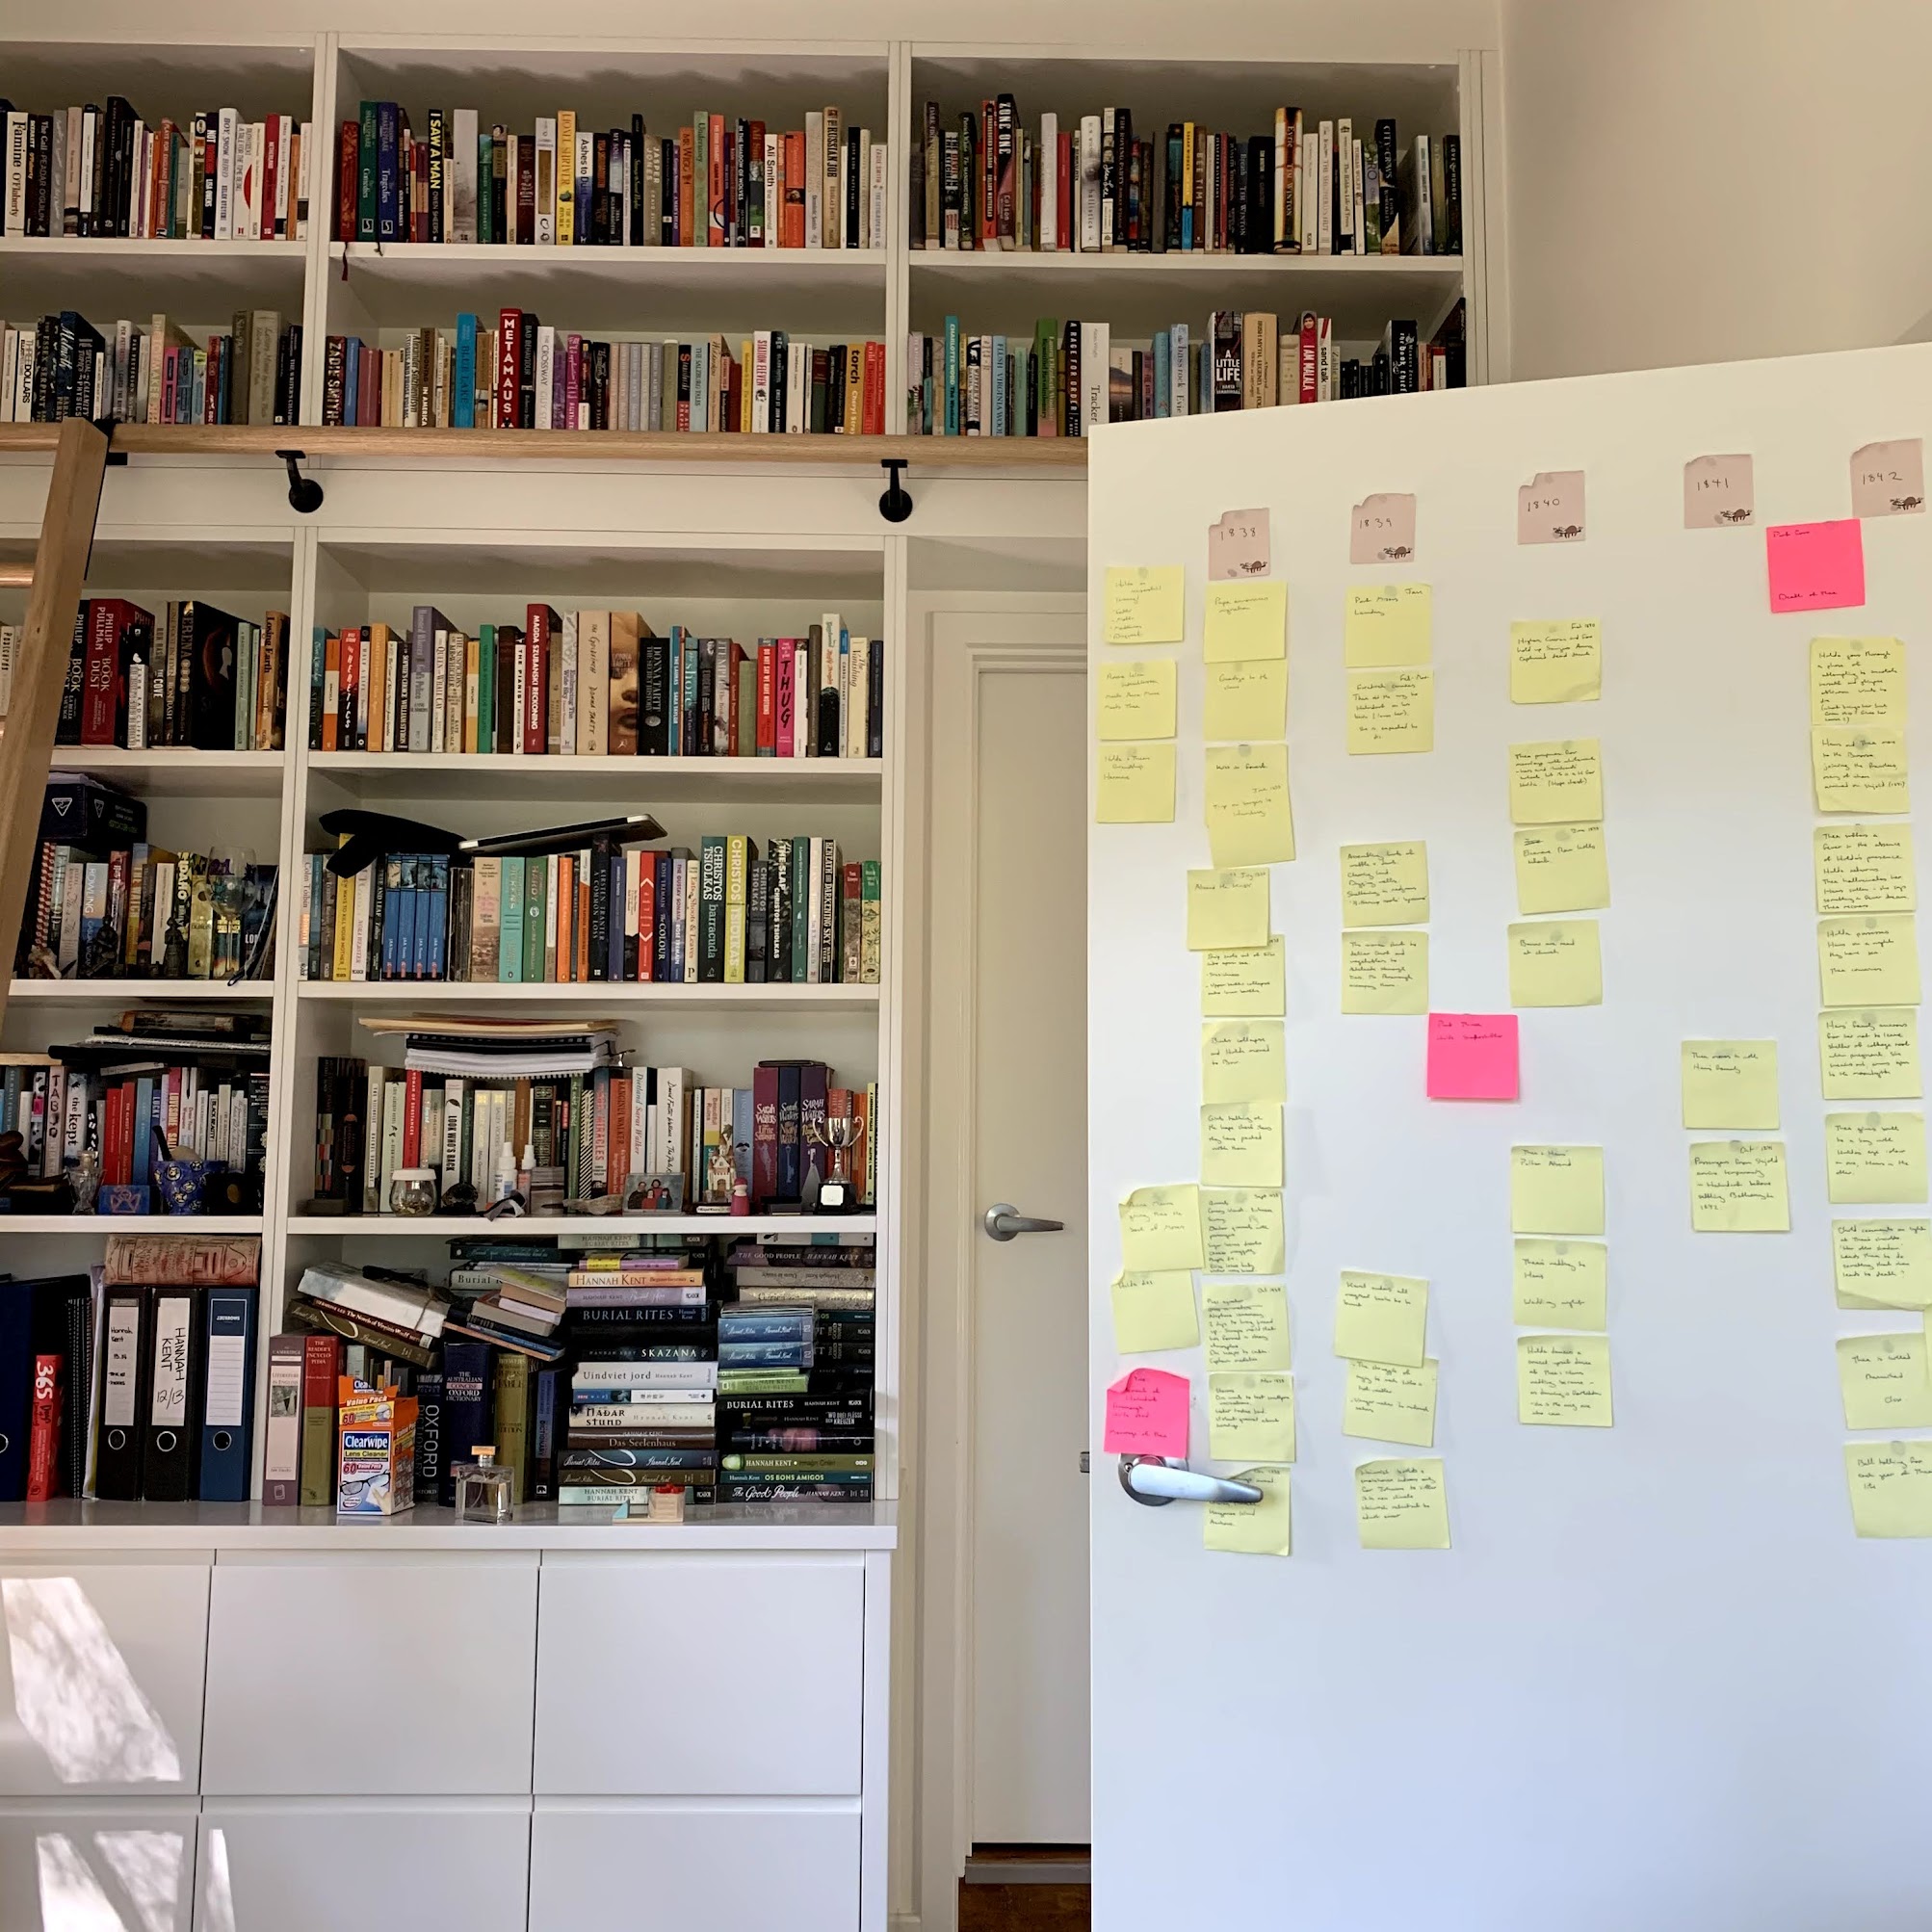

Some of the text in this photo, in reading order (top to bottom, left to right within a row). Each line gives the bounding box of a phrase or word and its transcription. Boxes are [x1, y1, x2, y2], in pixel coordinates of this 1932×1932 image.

[999, 103, 1011, 129] ZONE
[430, 120, 440, 147] SAW
[999, 134, 1011, 154] ONE
[430, 149, 440, 157] A
[580, 139, 589, 165] Ashes
[10, 121, 26, 217] Famine O'Flaherty
[430, 161, 440, 189] MAN
[767, 160, 775, 187] Smith
[380, 169, 390, 203] Tragedies
[59, 323, 75, 370] Melmoth
[1303, 349, 1315, 360] AM
[503, 318, 515, 413] METAMAUS
[756, 340, 767, 386] STATION ELEVEN
[1216, 368, 1241, 381] LIFE
[1303, 362, 1314, 390] MALALA
[39, 366, 47, 407] SERPENT
[327, 342, 341, 419] ZADIE SMITH
[850, 350, 860, 414] torch Cheryl
[1176, 346, 1187, 413] bass rock Evie
[1090, 385, 1100, 422] Tracker
[1862, 472, 1903, 485] 1842
[1528, 498, 1560, 512] 1840
[1221, 527, 1256, 541] 1838
[75, 614, 84, 644] PHILIP
[95, 607, 105, 650] PULLMAN
[104, 613, 114, 644] PHILIP
[436, 646, 445, 669] QUEEN
[848, 650, 861, 687] Vanishing
[71, 658, 82, 692] BOOK
[90, 661, 100, 689] DUST
[100, 658, 111, 692] BOOK
[652, 646, 662, 712] DONNA TARTT
[684, 663, 697, 707] shore
[703, 847, 713, 900] TSIOLKAS
[713, 846, 723, 900] CHRISTOS
[731, 839, 742, 900] CHRISTOS
[85, 868, 96, 914] ROWLING
[823, 842, 834, 945] BENEATH DARKENING SKY
[707, 904, 718, 959] barracuda
[152, 1096, 160, 1118] LUCKY
[757, 1104, 775, 1114] Sarah
[802, 1099, 824, 1111] SARAH
[66, 1114, 81, 1146] kept
[446, 1115, 457, 1172] LOOK WHO'S BACK
[458, 1275, 491, 1283] Burial
[576, 1274, 646, 1285] HANNAH KENT
[583, 1310, 674, 1320] BURIAL RITES
[162, 1338, 173, 1371] KENT
[175, 1327, 185, 1381] HANNAH
[36, 1361, 54, 1400] 365
[583, 1372, 626, 1380] Uindviet
[631, 1371, 651, 1381] jord
[157, 1389, 185, 1410] 12/13
[346, 1398, 368, 1407] Value
[342, 1414, 355, 1425] 60
[345, 1435, 388, 1449] Clearwipe
[423, 1405, 440, 1477] OXFORD
[609, 1439, 676, 1447] Das Seelenhaus
[732, 1488, 744, 1496] The
[745, 1486, 772, 1501] Good
[771, 1485, 800, 1499] People
